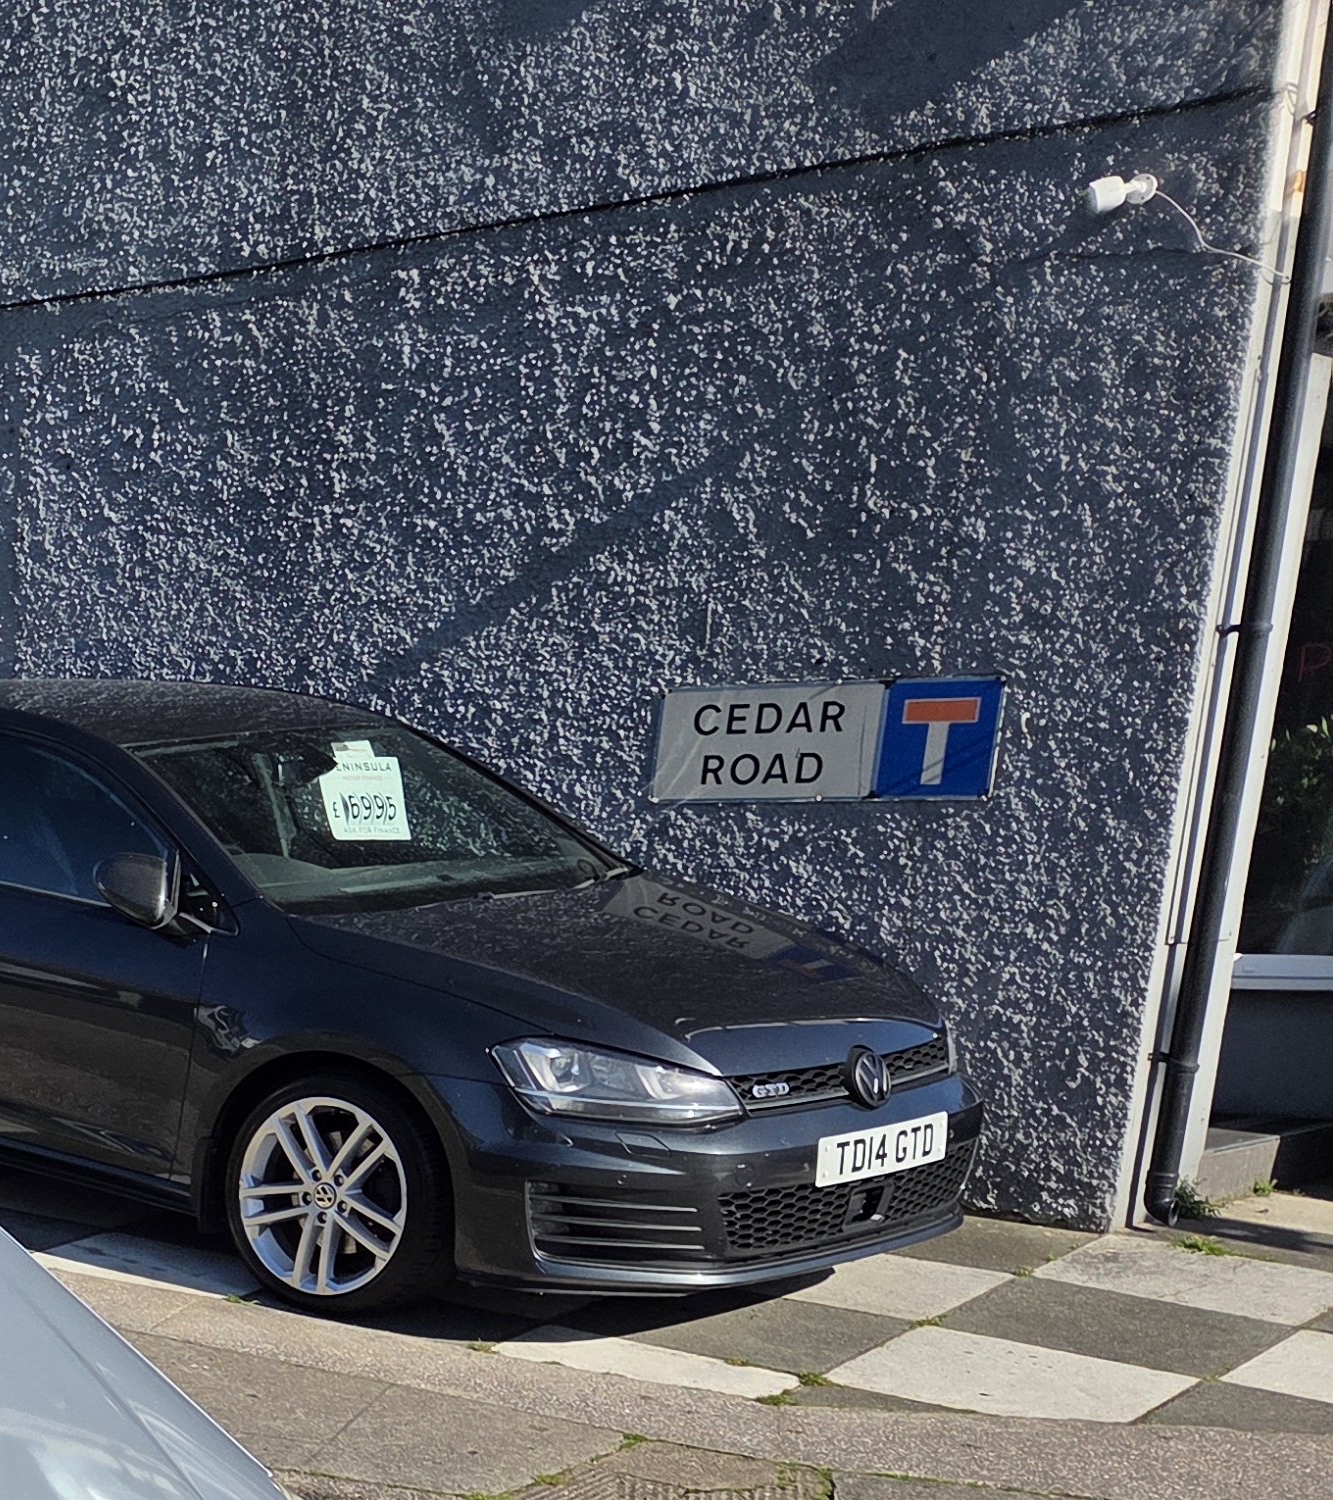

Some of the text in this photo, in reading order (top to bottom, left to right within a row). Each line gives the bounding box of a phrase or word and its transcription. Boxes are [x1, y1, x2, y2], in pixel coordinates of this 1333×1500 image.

[693, 700, 845, 736] CEDAR
[335, 762, 392, 772] ENINSULA
[700, 752, 823, 786] ROAD
[332, 793, 397, 821] £ 6995
[752, 1082, 790, 1099] GTD
[836, 1123, 934, 1176] TD14 GTD
